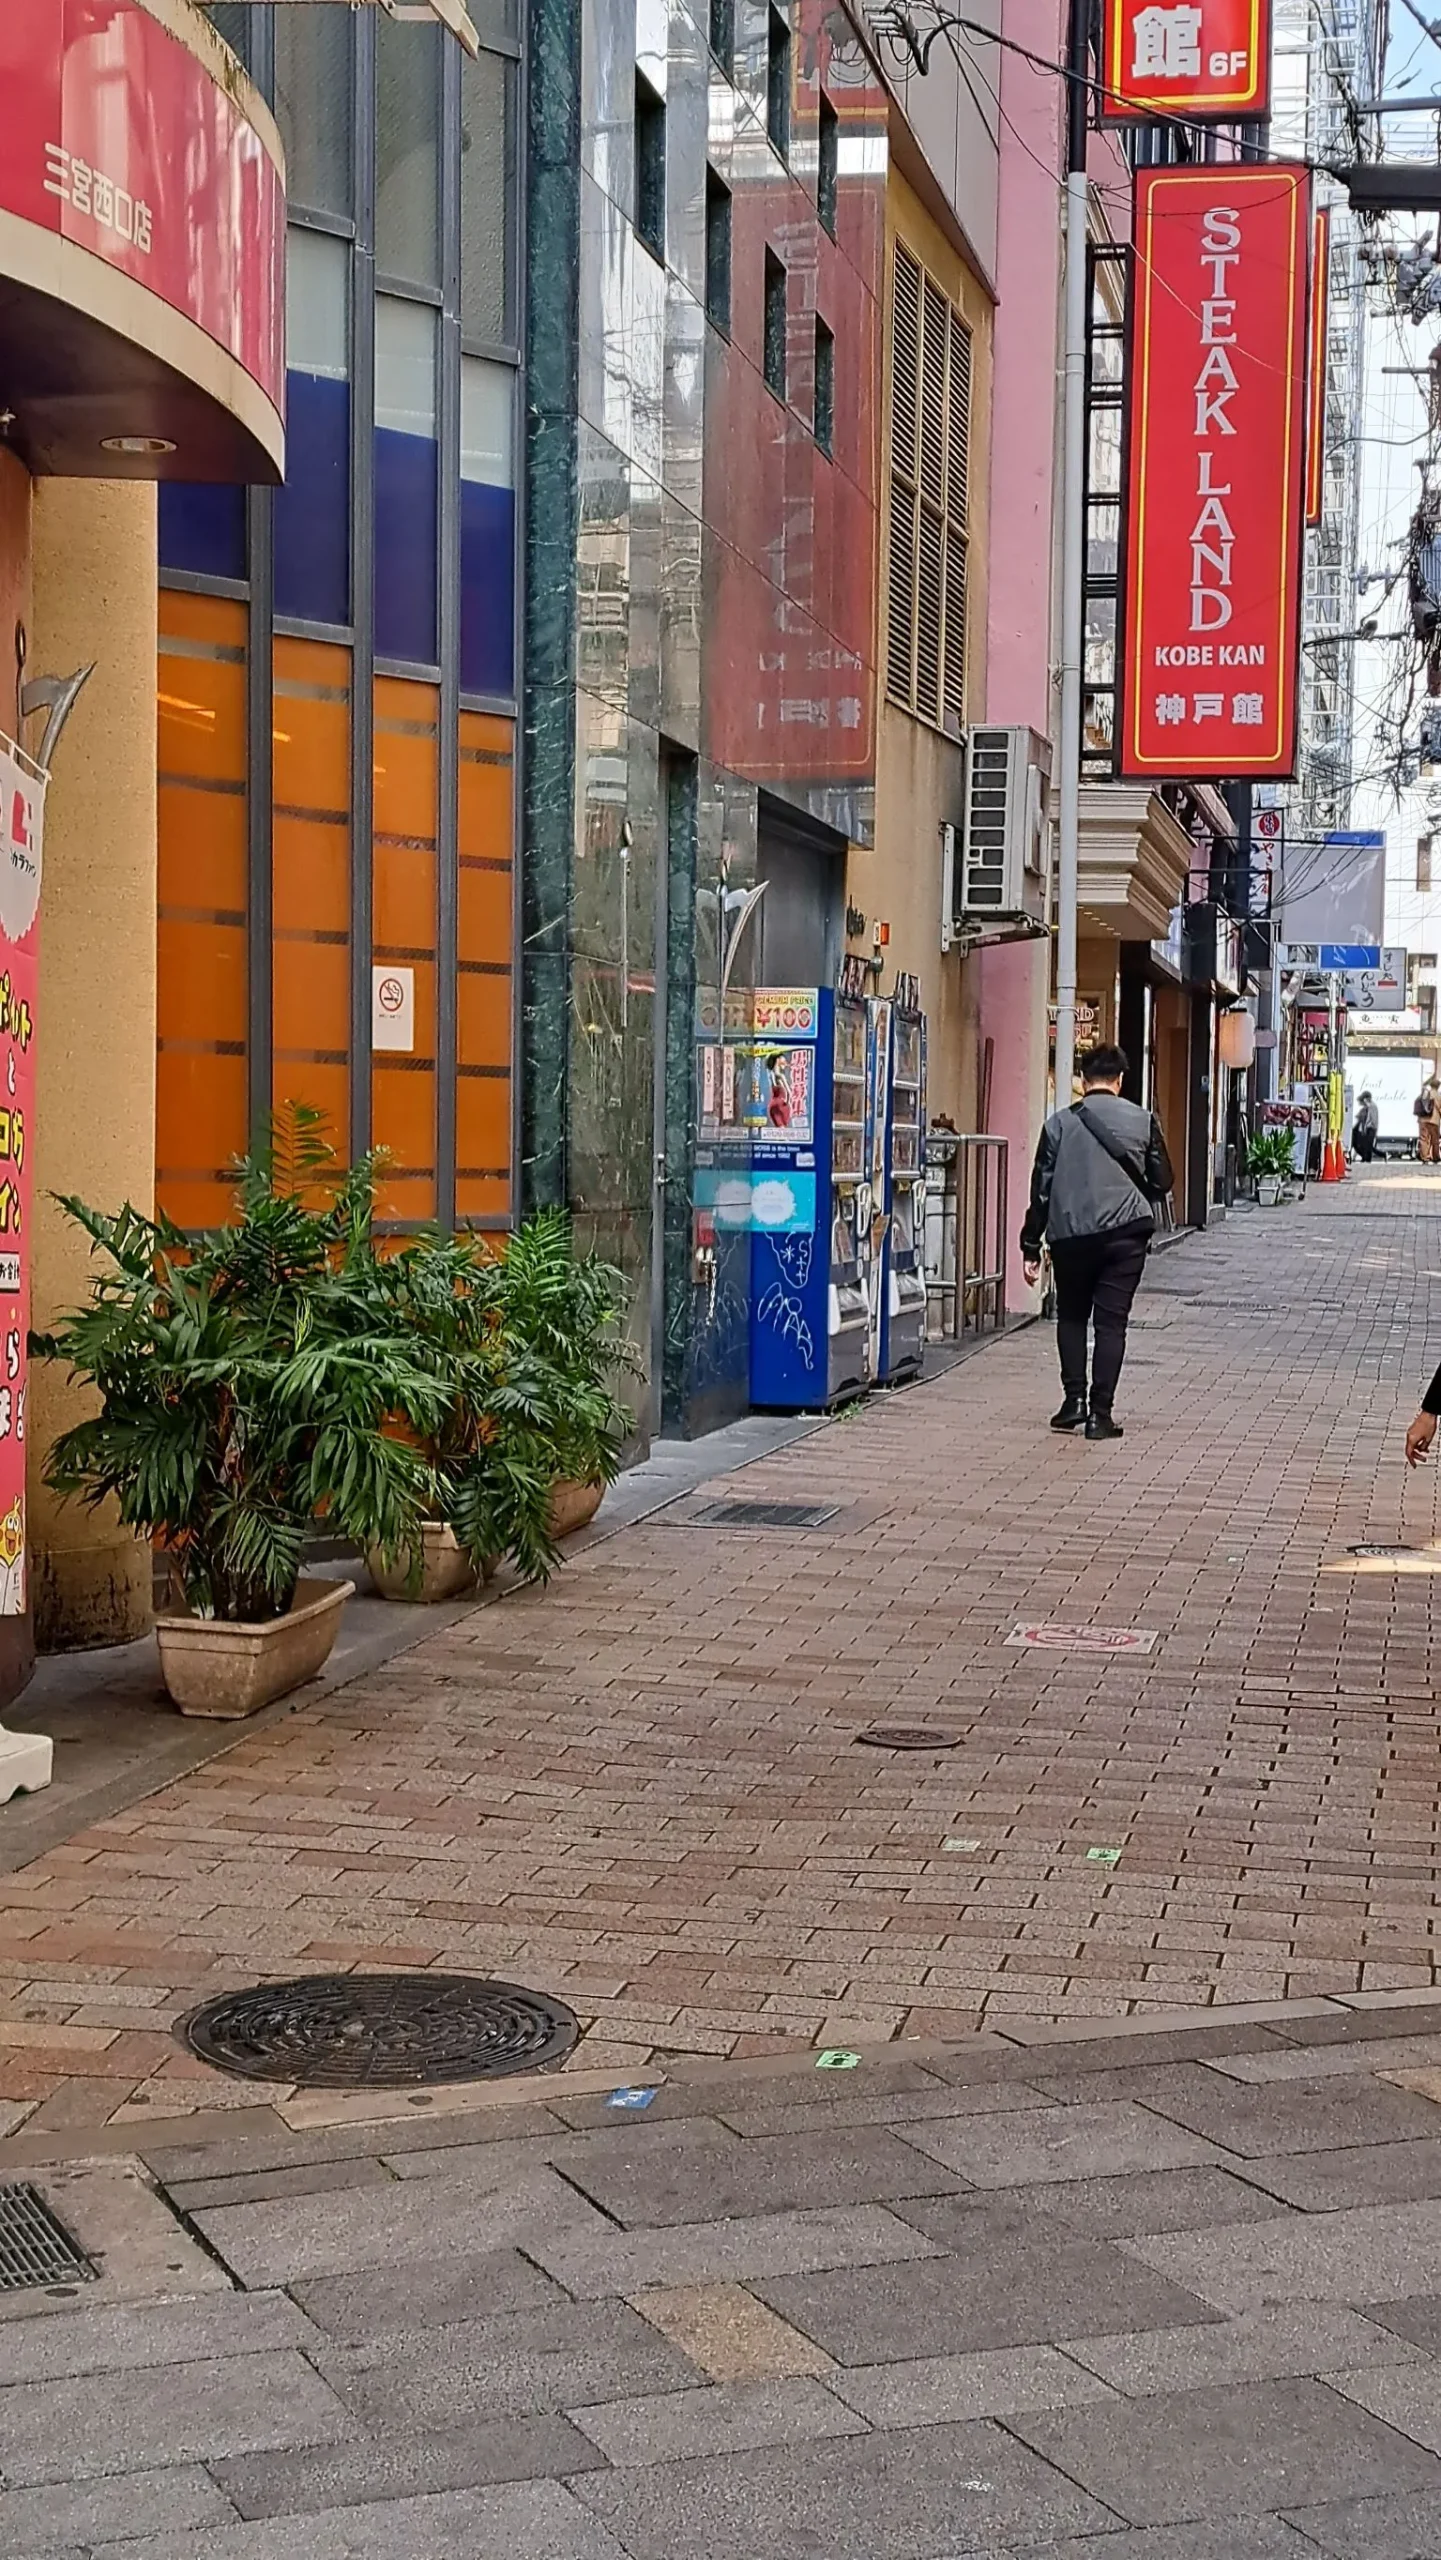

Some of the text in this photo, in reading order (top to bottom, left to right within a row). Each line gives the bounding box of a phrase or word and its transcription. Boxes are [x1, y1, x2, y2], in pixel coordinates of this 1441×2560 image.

[1131, 4, 1247, 78] 館 6F
[43, 141, 152, 254] 三宮西口店
[1188, 206, 1241, 632] STEAK LAND
[1155, 645, 1265, 666] KOBE KAN
[1155, 692, 1264, 726] 神戸館
[755, 1006, 812, 1029] ¥100
